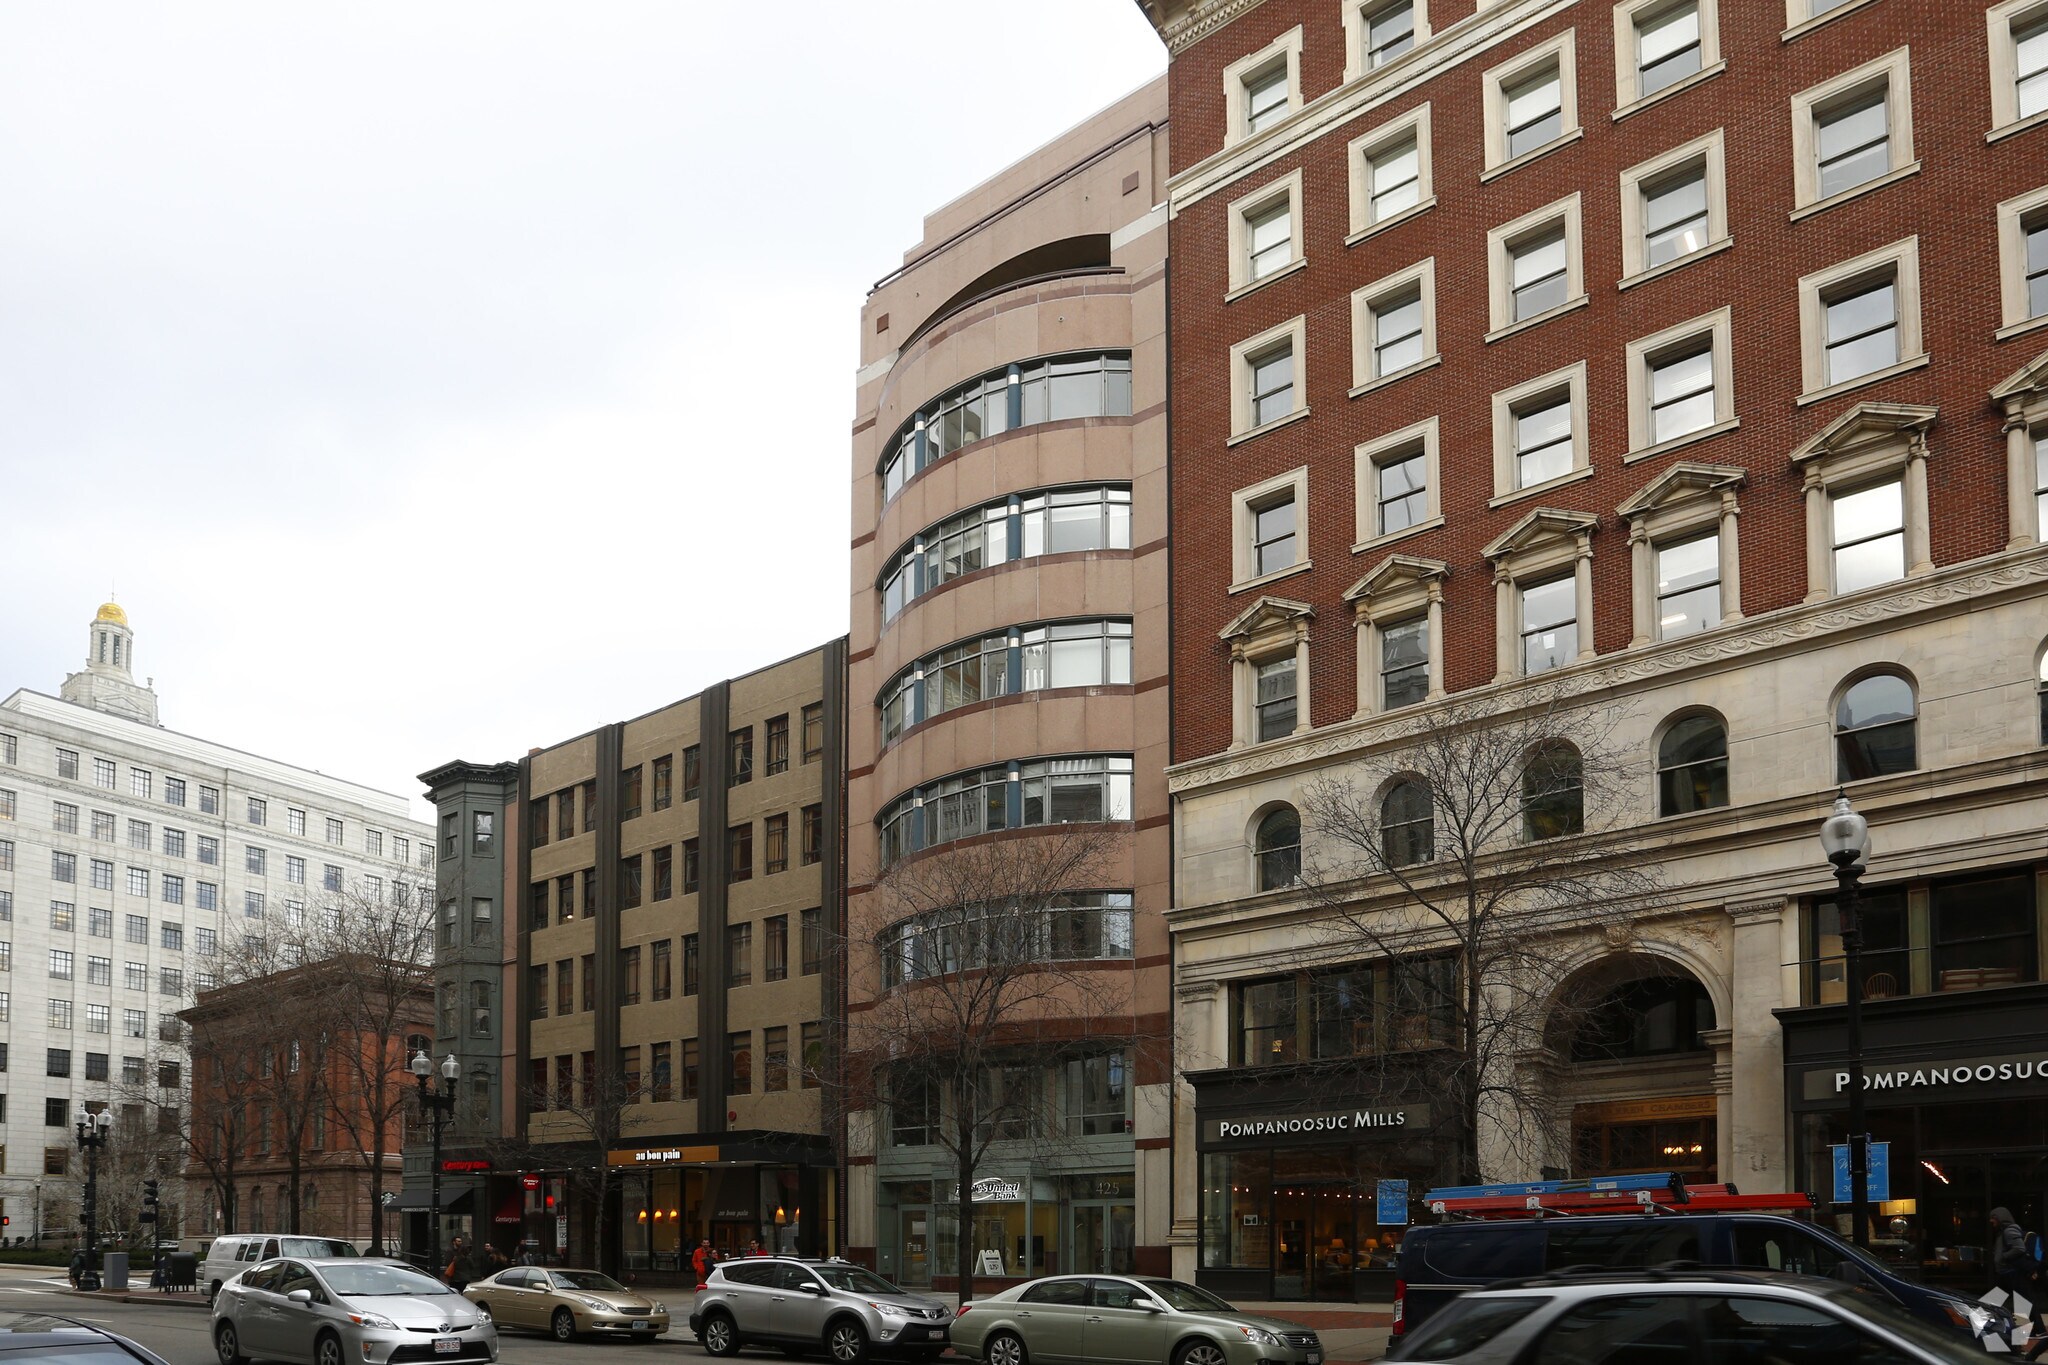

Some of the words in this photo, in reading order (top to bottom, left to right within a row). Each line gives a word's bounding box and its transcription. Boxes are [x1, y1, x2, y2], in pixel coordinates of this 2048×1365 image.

[1220, 1116, 1348, 1137] POMPANOOSUC
[1354, 1111, 1405, 1128] MILLS
[635, 1152, 646, 1161] au
[646, 1149, 661, 1160] bon
[662, 1148, 681, 1162] pain
[1095, 1182, 1120, 1195] 425
[994, 1191, 1018, 1200] Bank
